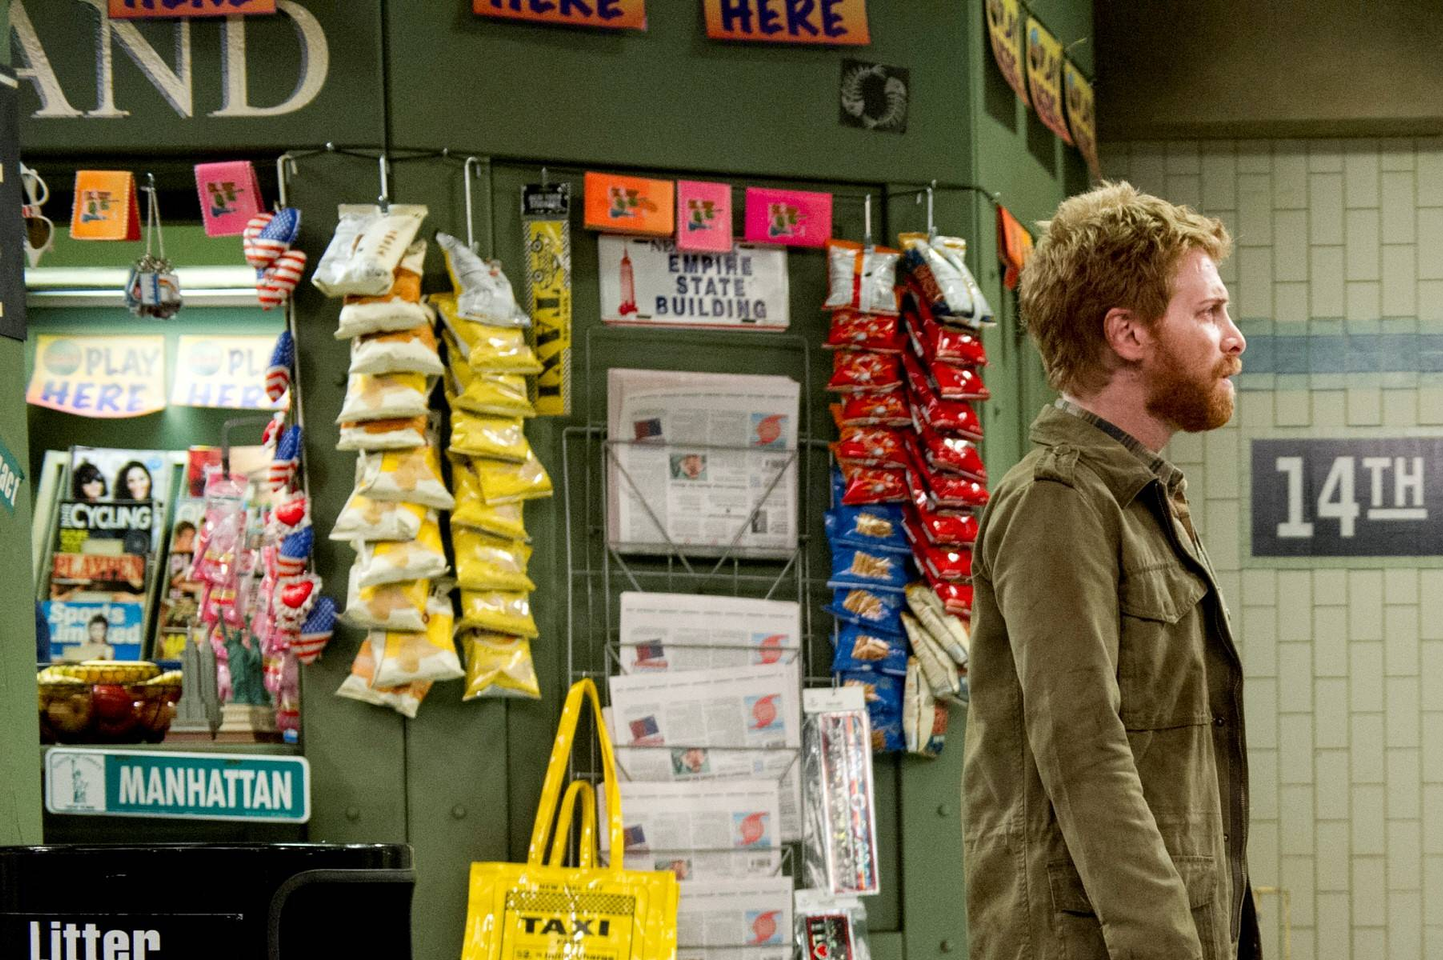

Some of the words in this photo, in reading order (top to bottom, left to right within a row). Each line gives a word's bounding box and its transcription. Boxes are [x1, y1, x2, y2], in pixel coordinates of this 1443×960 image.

[720, 0, 850, 38] HERE
[667, 254, 753, 276] EMPIRE
[676, 275, 747, 297] STATE
[655, 295, 768, 319] BUILDING
[86, 346, 161, 378] PLAY
[41, 379, 148, 413] HERE
[187, 382, 268, 409] HER
[1275, 456, 1428, 538] 14TH
[70, 502, 153, 531] CYCLING
[118, 764, 293, 811] MANHATTAN
[520, 916, 610, 937] TAXI
